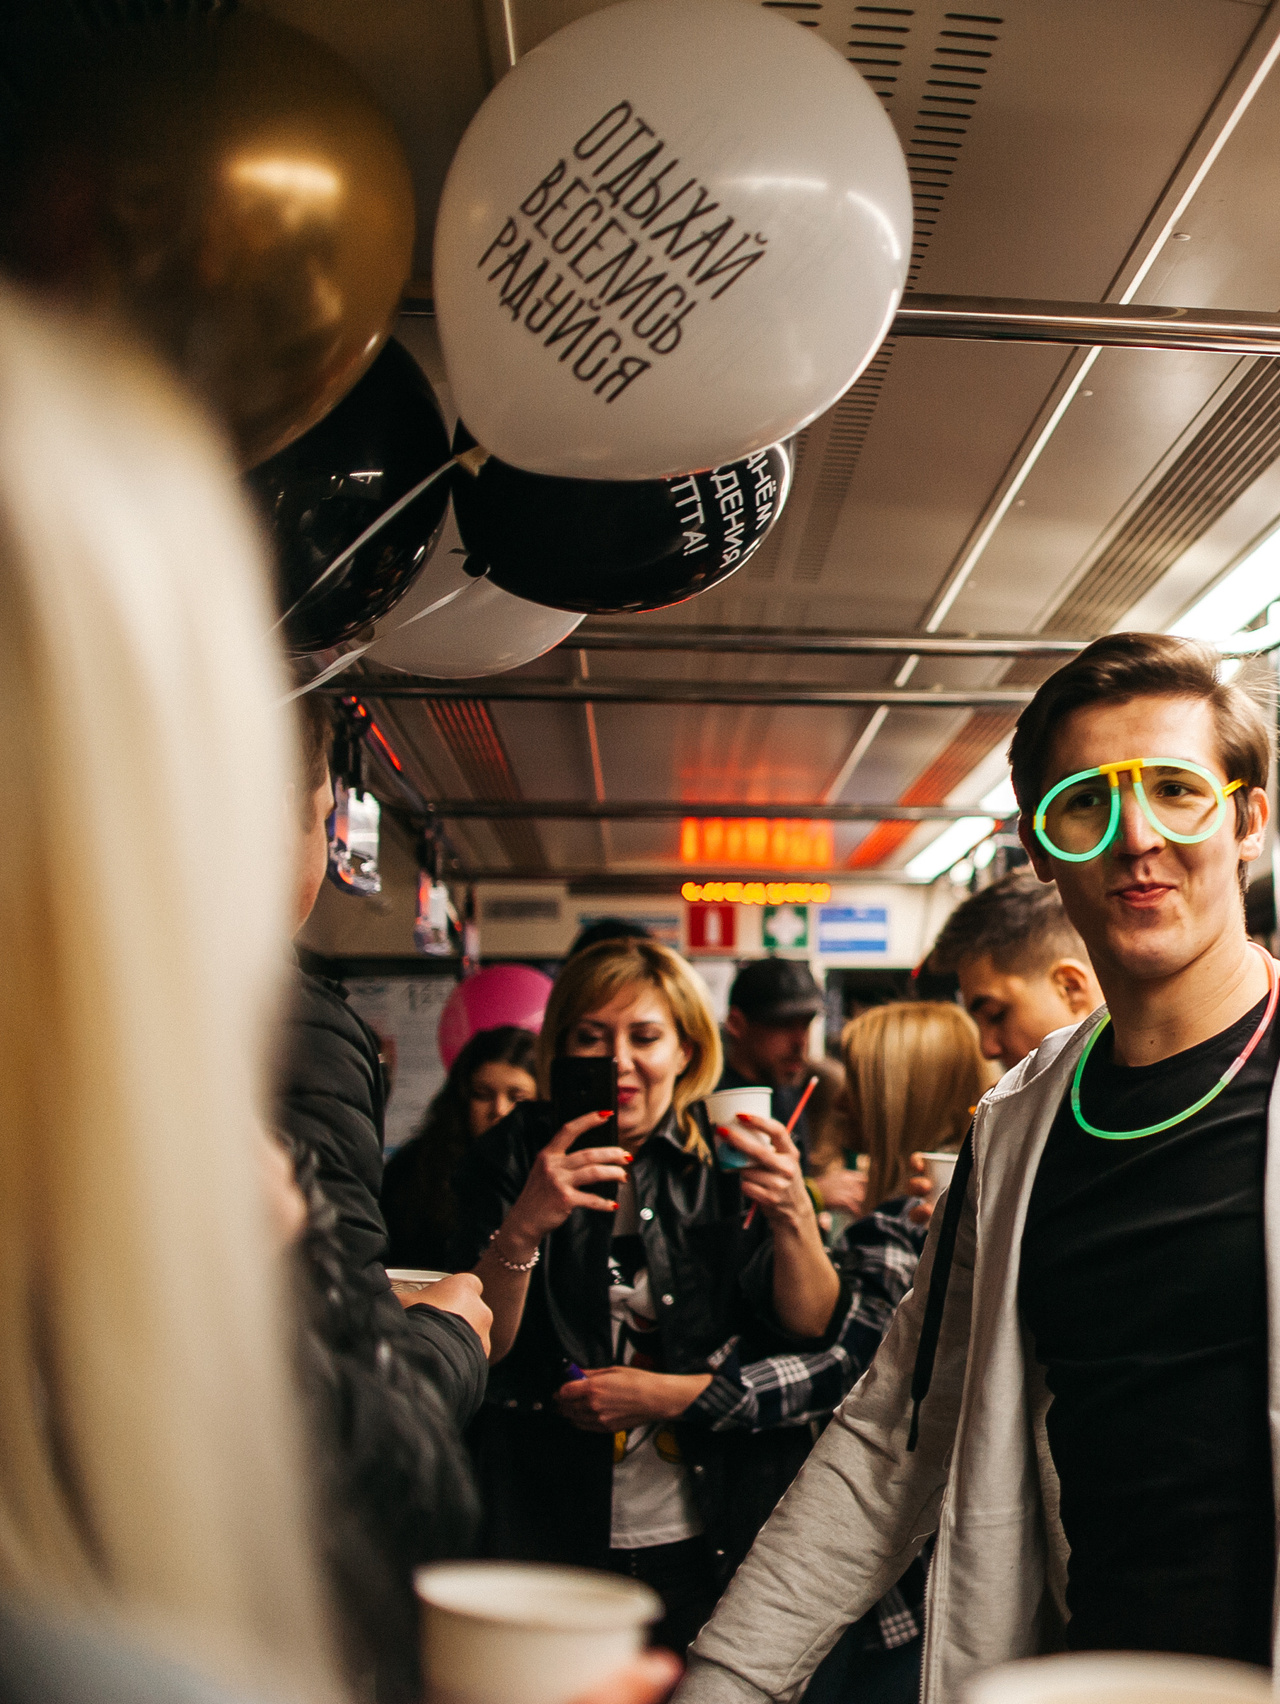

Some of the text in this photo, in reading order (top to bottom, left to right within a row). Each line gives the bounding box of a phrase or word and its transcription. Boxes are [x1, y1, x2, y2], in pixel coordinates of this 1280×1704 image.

[519, 158, 697, 354] ВЕСЕЛИСЬ
[573, 100, 768, 301] ОТДЫХАЙ
[477, 216, 652, 403] РАДУЙСЯ
[666, 475, 710, 556] ПТА!
[710, 467, 745, 569] ДЕНИЯ
